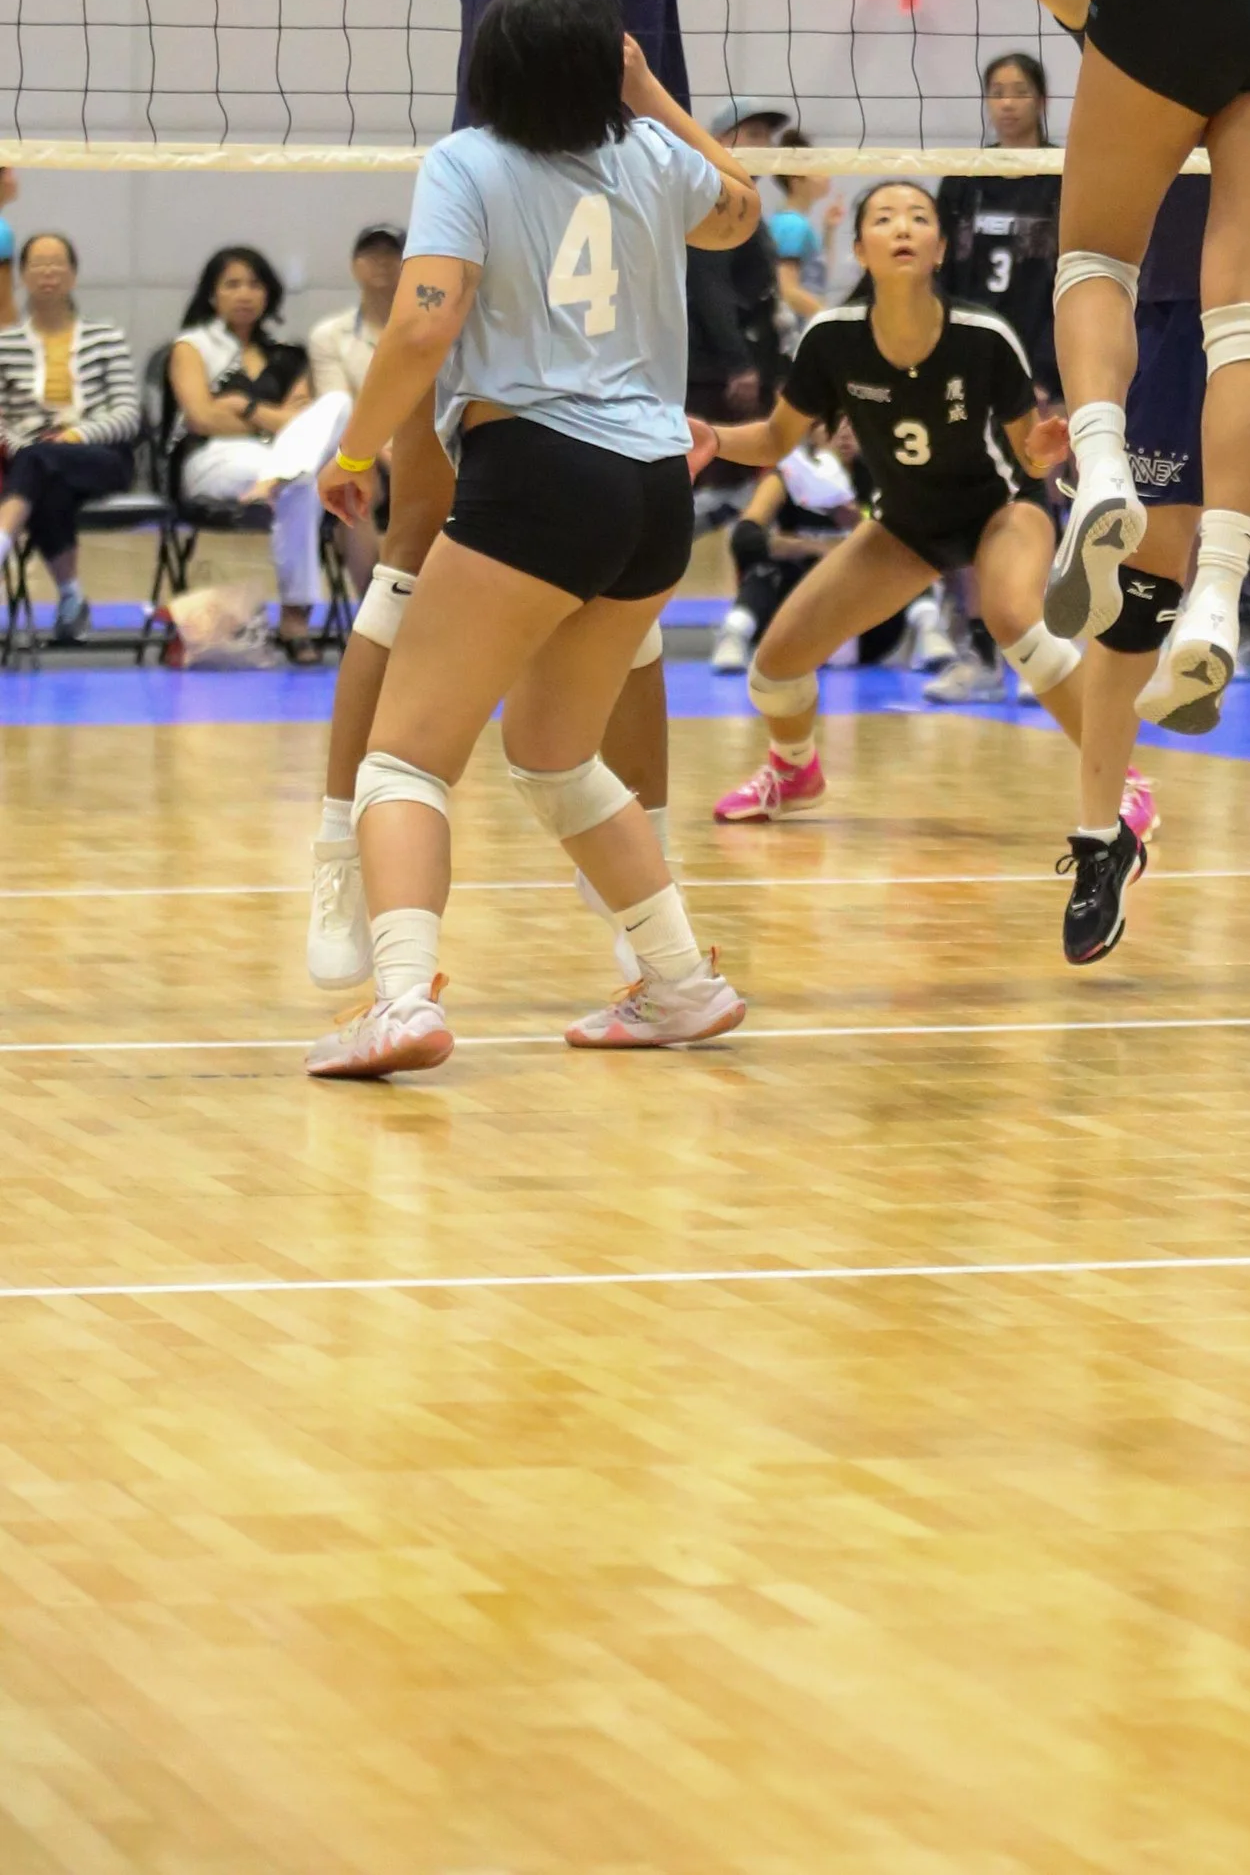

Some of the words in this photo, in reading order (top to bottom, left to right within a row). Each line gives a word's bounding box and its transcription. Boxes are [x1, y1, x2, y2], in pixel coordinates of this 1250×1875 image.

[548, 193, 620, 337] 4
[986, 246, 1014, 293] 3
[892, 420, 932, 466] 3
